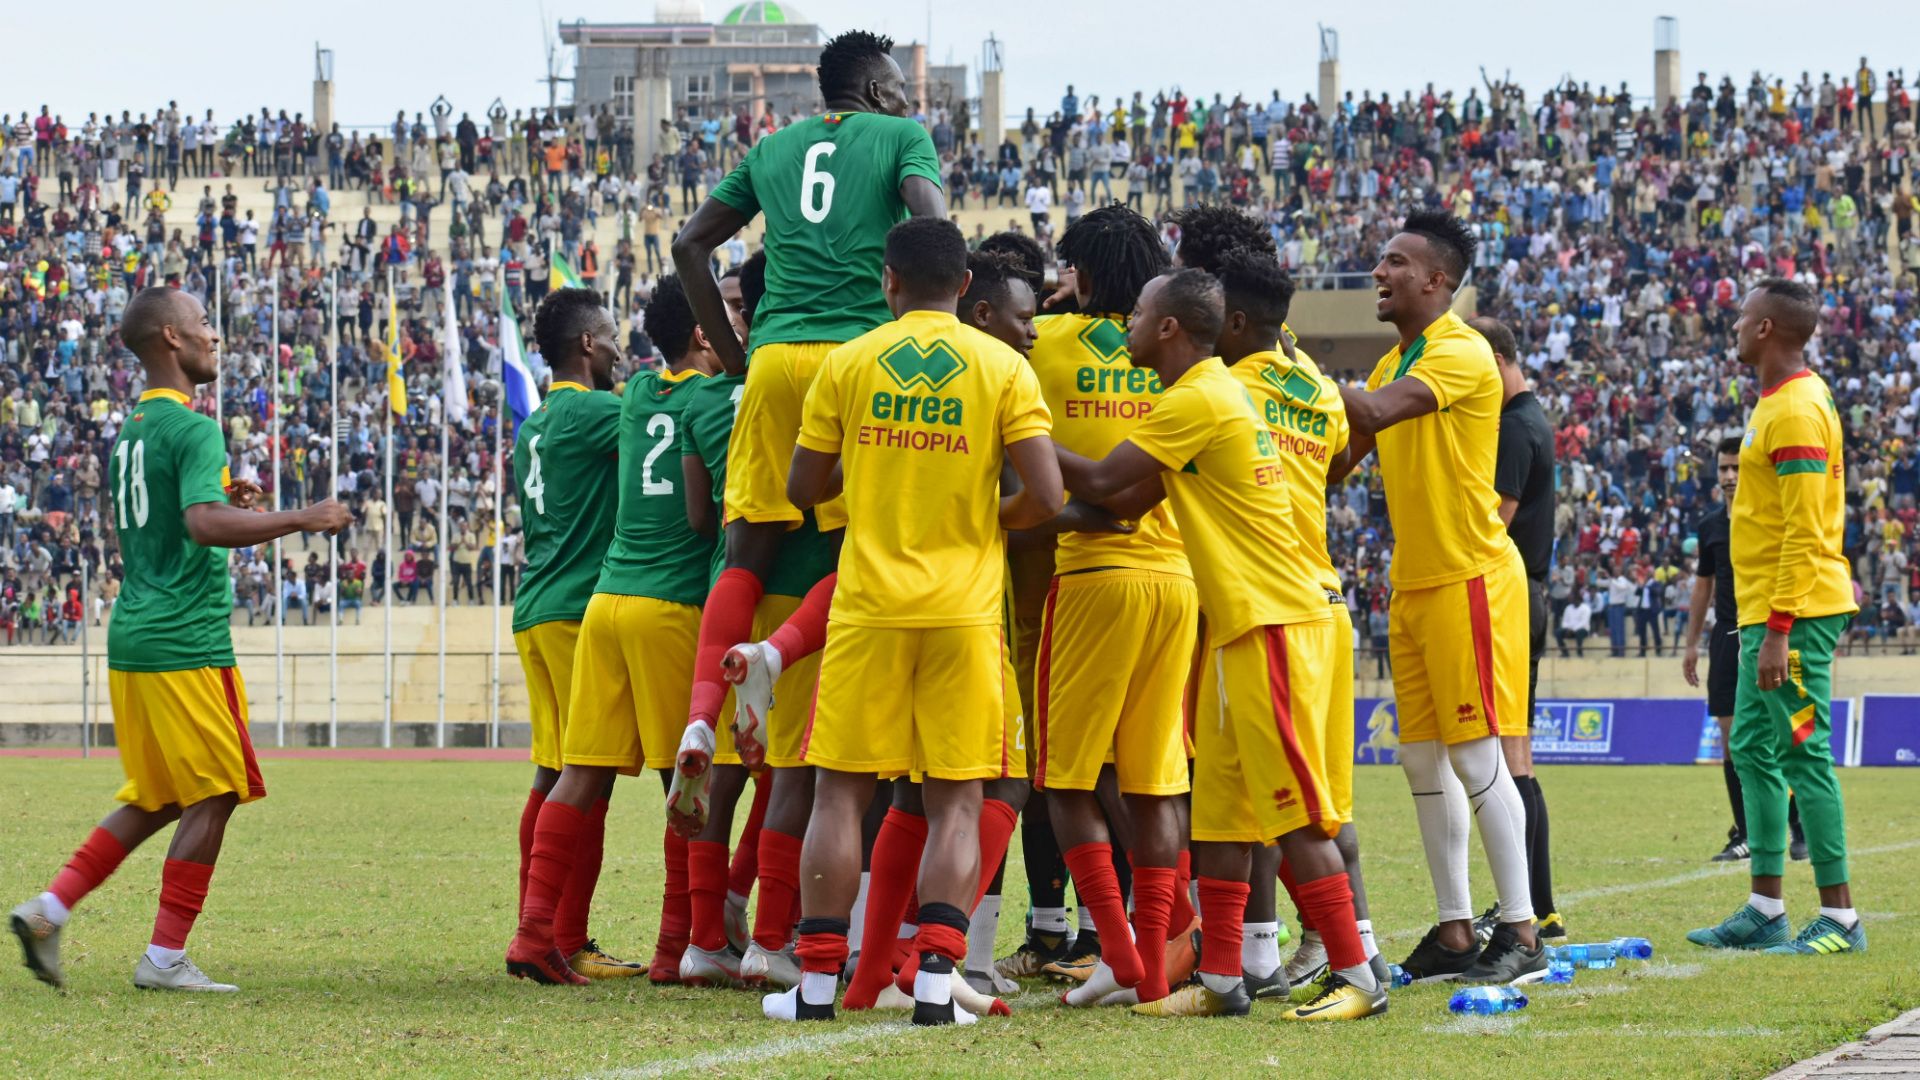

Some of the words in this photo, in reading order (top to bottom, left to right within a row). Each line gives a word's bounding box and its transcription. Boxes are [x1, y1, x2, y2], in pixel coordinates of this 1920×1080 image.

[801, 141, 837, 224] 6
[858, 425, 969, 455] ETHIOPIA
[1065, 400, 1152, 419] ETHIOP
[1269, 430, 1327, 464] THIOPIA
[115, 439, 150, 530] 18
[523, 433, 545, 515] 4
[642, 412, 675, 496] 2
